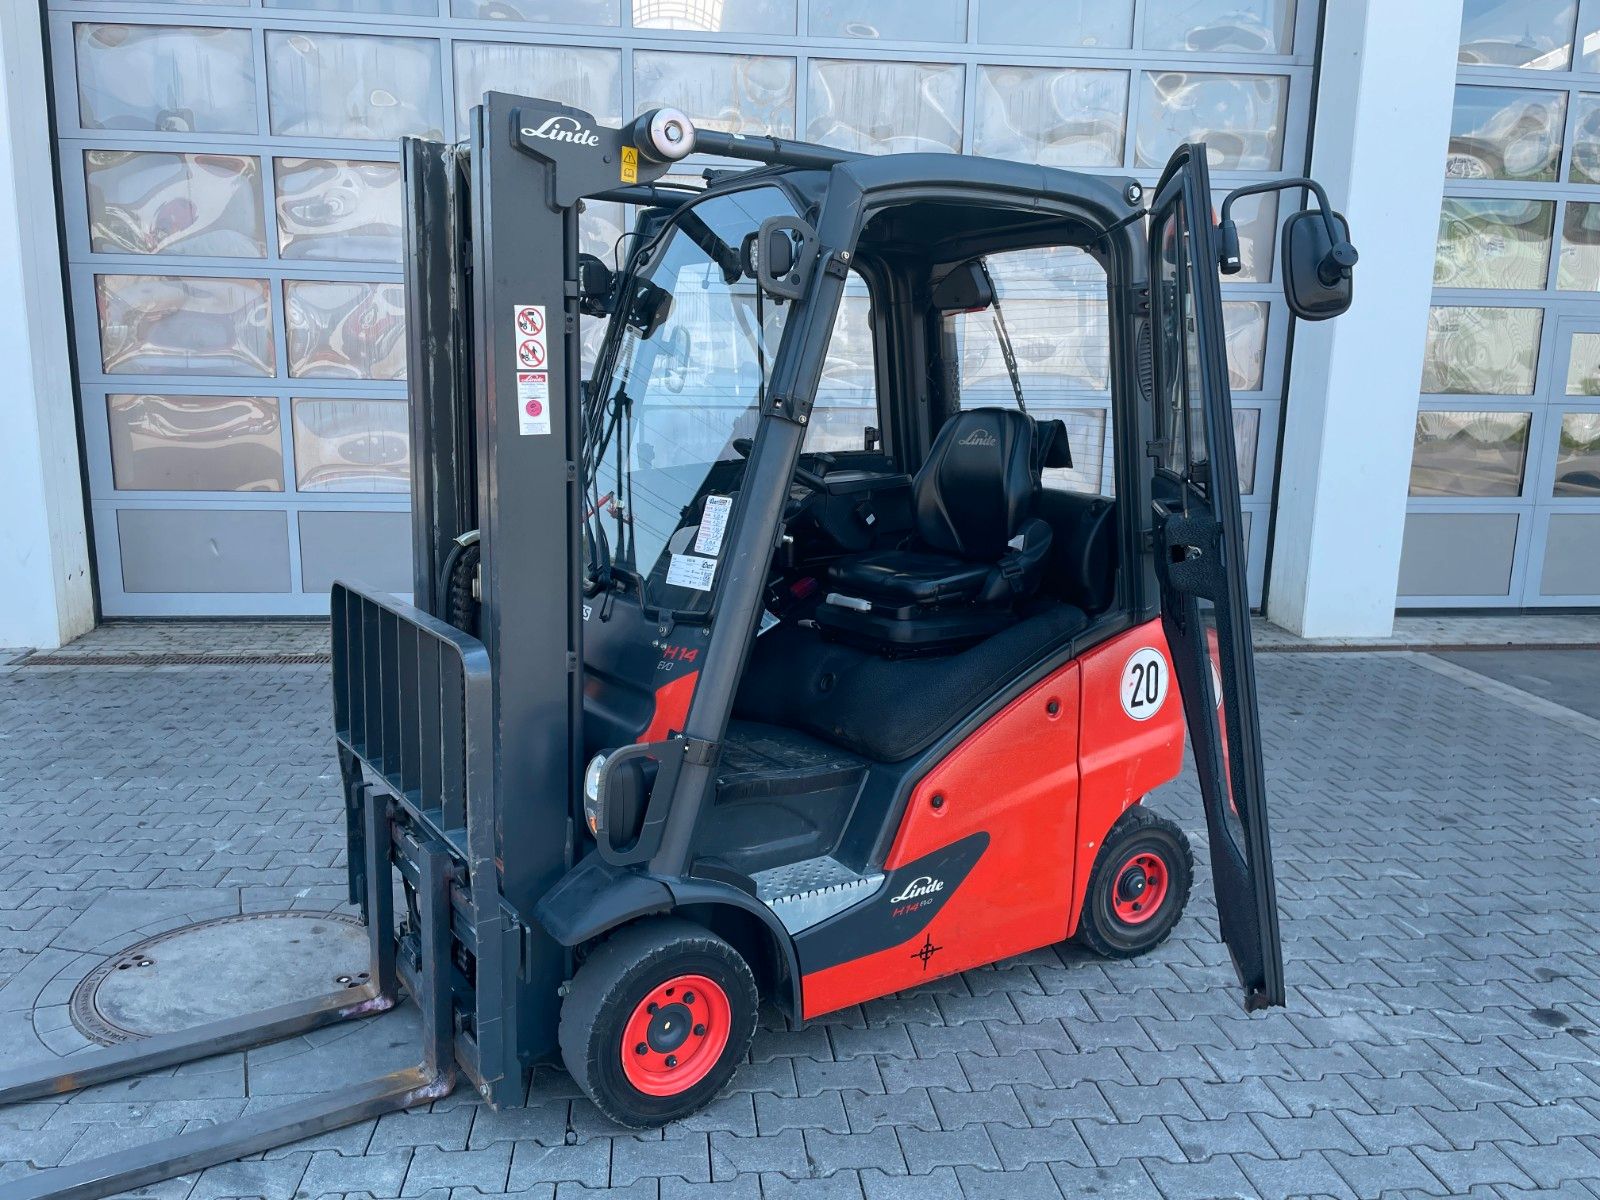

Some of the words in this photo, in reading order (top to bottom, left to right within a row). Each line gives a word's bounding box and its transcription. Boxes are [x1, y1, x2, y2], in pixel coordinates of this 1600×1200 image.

[520, 116, 600, 147] Linde
[959, 429, 997, 446] Linde
[663, 645, 699, 662] H14
[657, 661, 674, 671] EVO
[1131, 660, 1159, 708] 20
[891, 876, 944, 903] Linde
